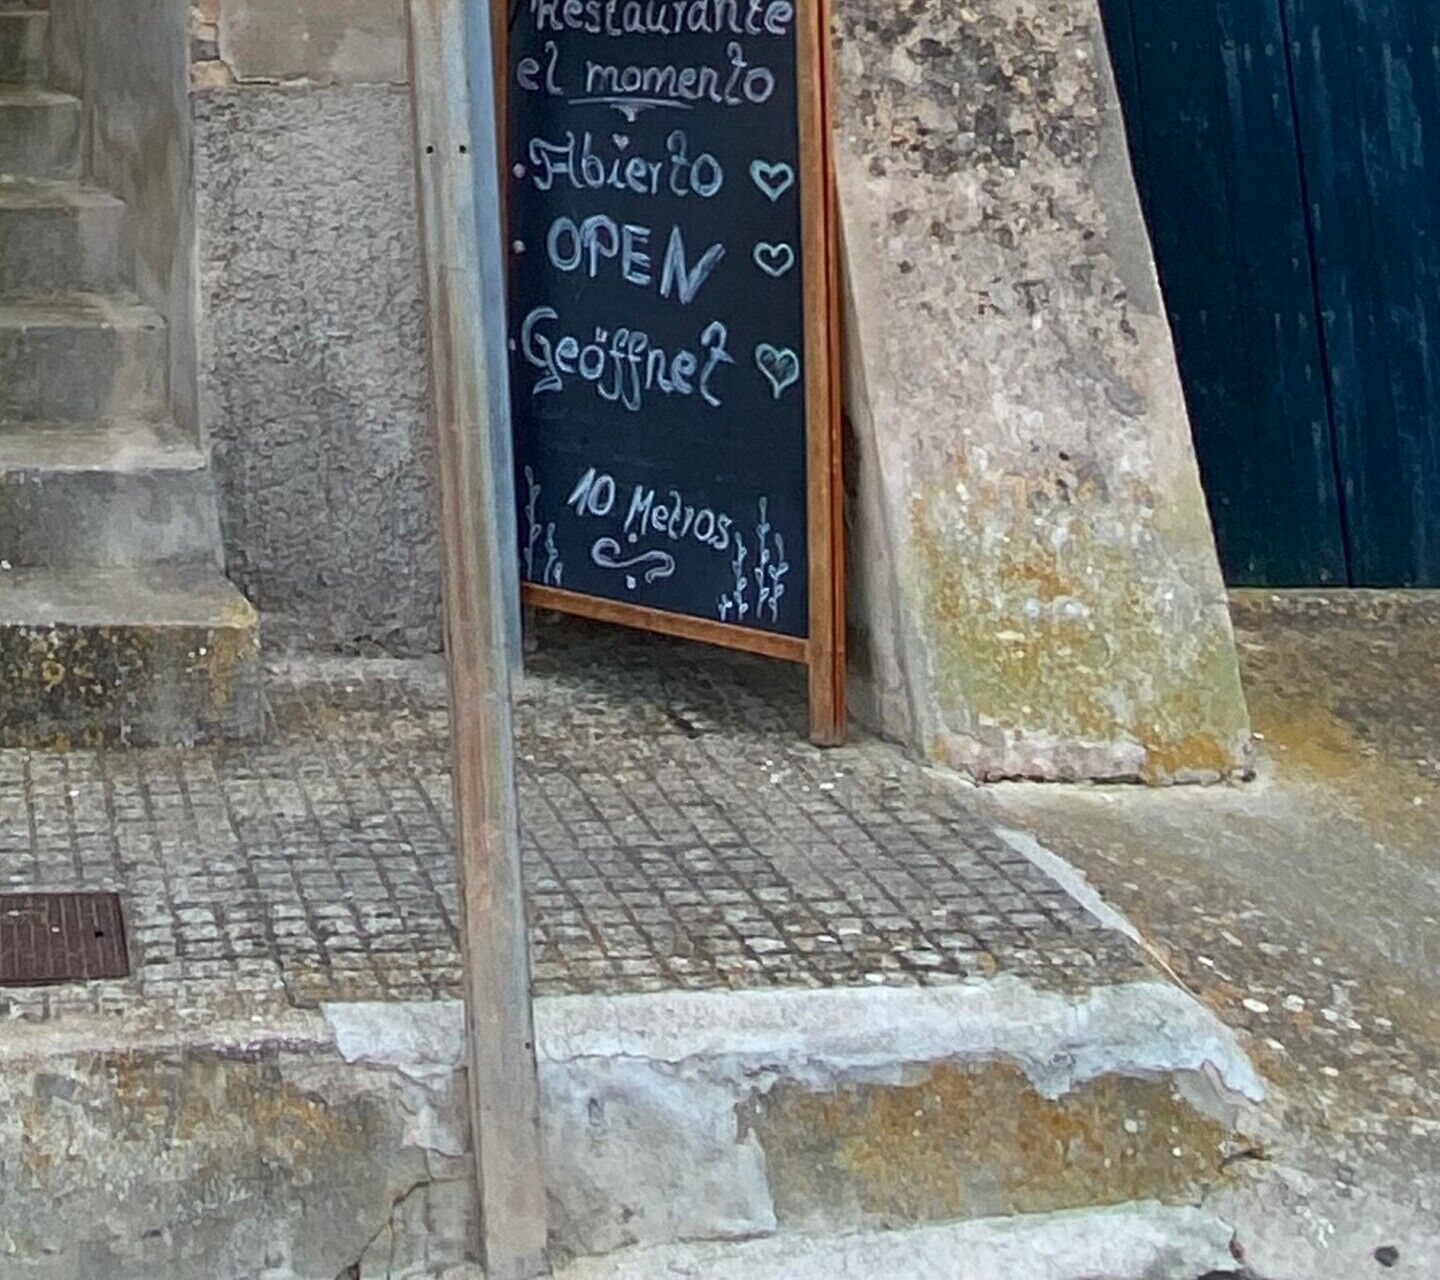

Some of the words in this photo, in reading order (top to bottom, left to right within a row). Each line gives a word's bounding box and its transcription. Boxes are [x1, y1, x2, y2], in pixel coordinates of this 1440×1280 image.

[516, 40, 564, 96] el
[585, 40, 775, 107] momento
[528, 129, 724, 198] Abierto
[546, 214, 727, 305] OPEN
[520, 306, 737, 412] Geöffnet
[567, 467, 616, 517] 10
